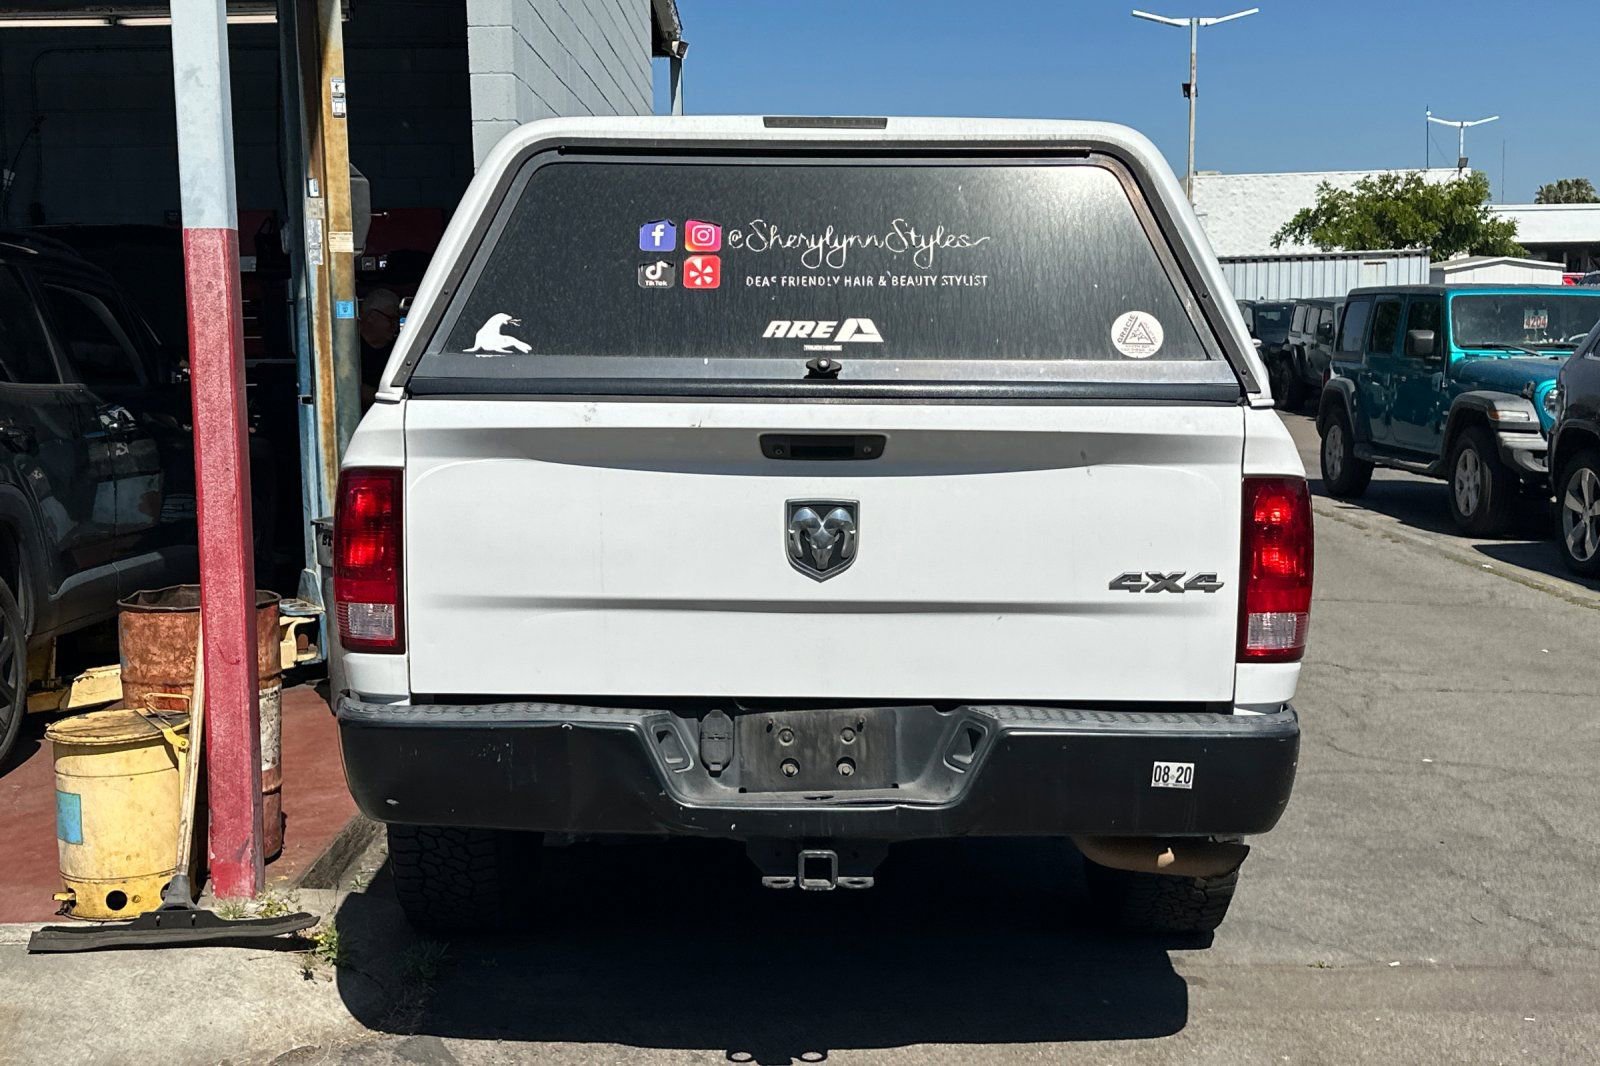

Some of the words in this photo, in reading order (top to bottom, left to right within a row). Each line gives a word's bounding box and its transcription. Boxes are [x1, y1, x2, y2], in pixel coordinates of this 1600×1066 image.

[781, 275, 840, 287] FRIENDLY
[844, 275, 874, 287] HAIR
[878, 275, 887, 286] &
[891, 275, 938, 287] BEAUTY
[941, 275, 988, 287] STYLIST
[1154, 765, 1170, 783] 08
[1175, 766, 1192, 784] 20
